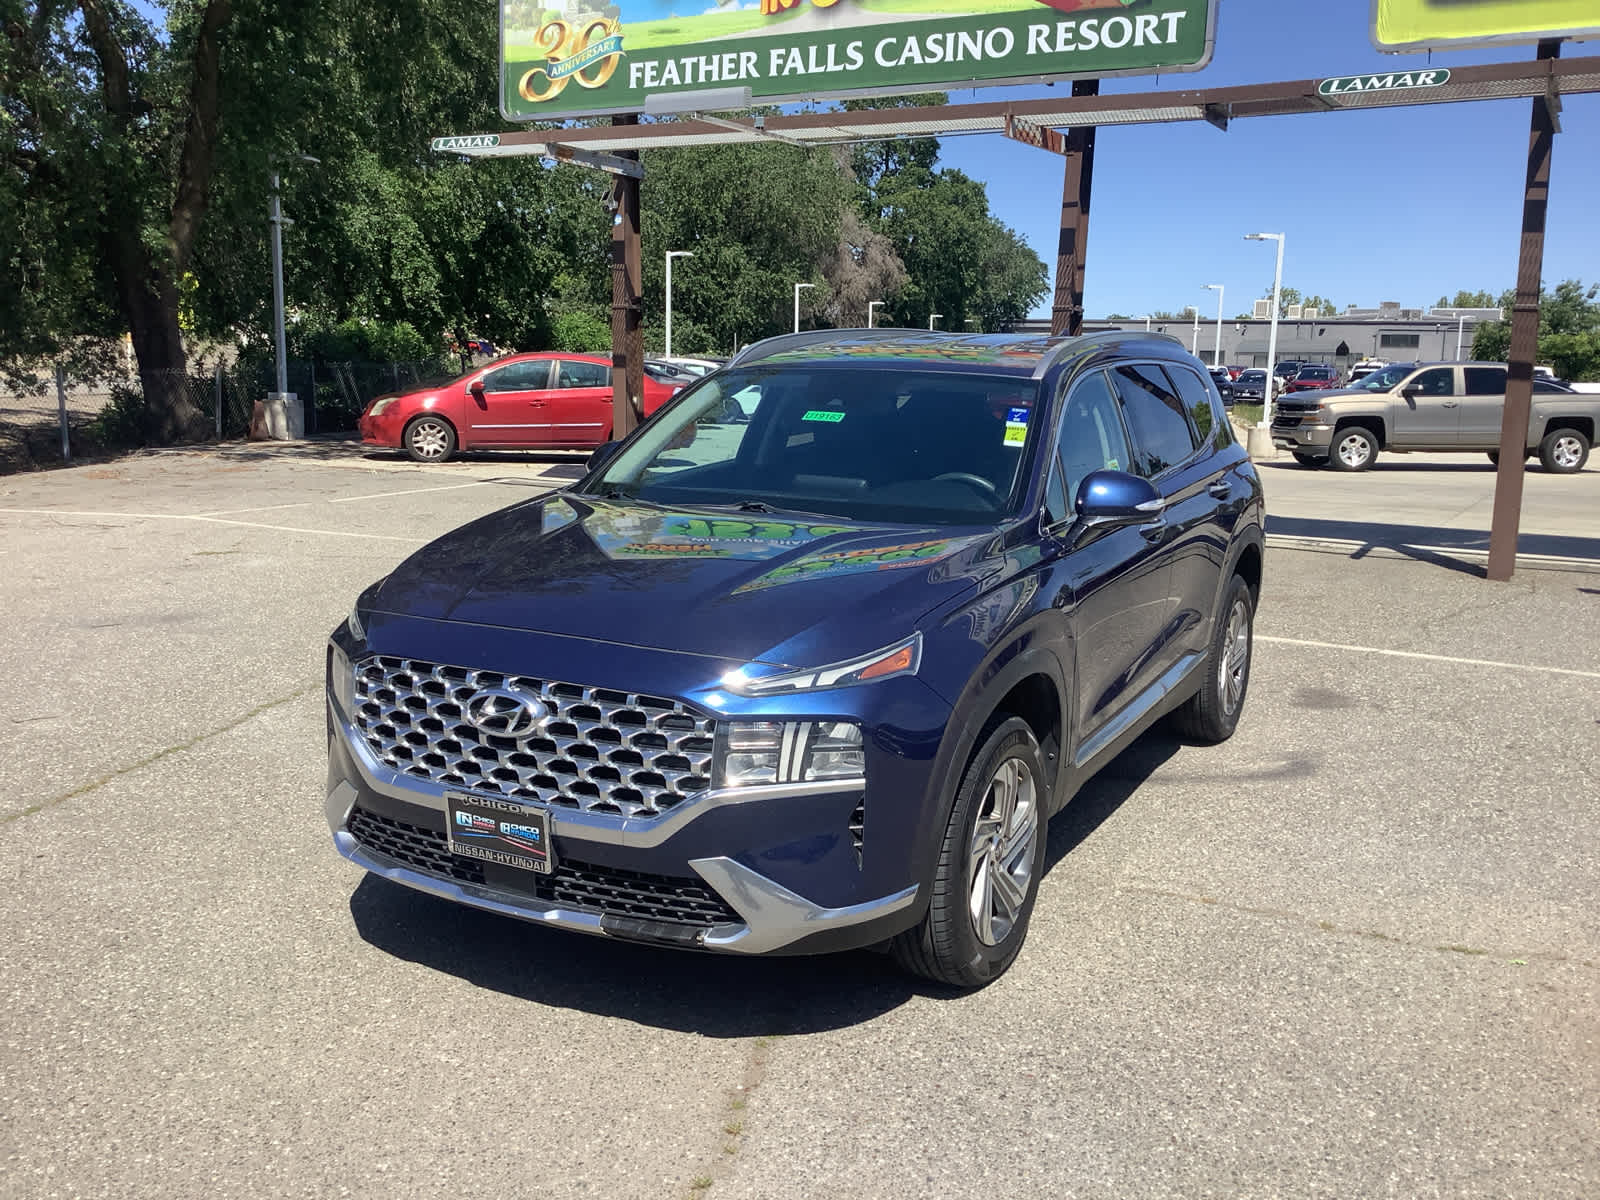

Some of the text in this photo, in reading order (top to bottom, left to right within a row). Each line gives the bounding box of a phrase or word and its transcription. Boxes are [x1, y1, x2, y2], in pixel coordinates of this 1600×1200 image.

[551, 38, 616, 77] ANNIVERSARY
[629, 11, 1187, 88] FEATHER FALLS CASINO RESORT
[1329, 71, 1438, 93] LAMAR
[438, 136, 494, 149] LAMAR
[468, 797, 522, 814] CHICO
